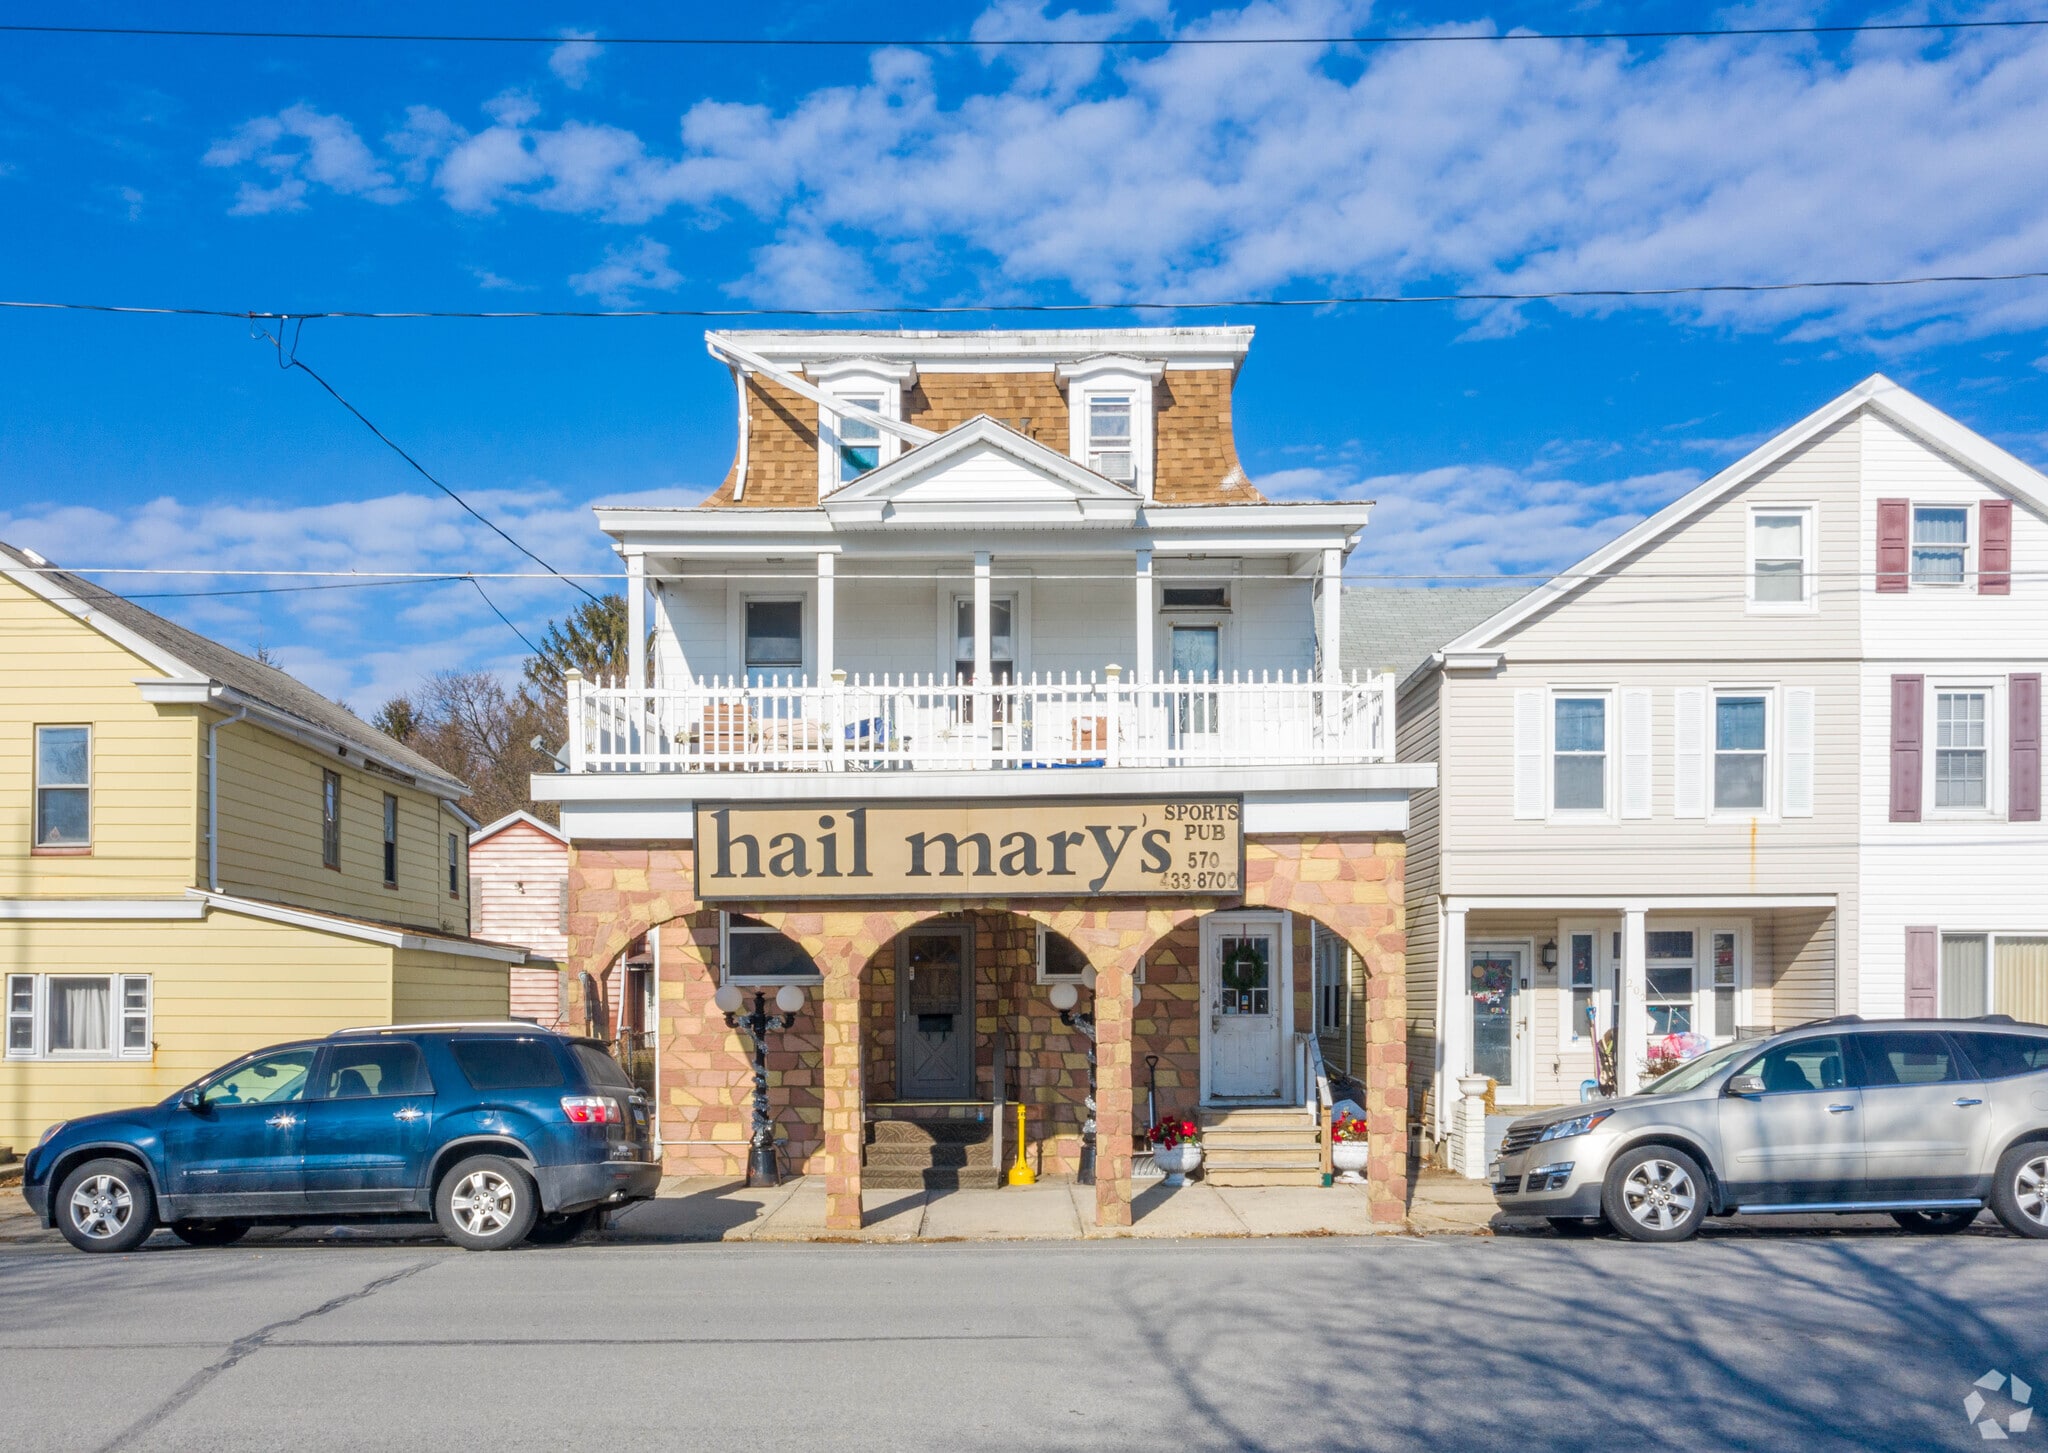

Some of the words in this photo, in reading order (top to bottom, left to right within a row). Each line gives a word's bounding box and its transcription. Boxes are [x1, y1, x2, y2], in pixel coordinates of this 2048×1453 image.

[1164, 804, 1239, 821] SPORTS
[1184, 824, 1226, 841] PUB
[710, 807, 873, 878] hail
[904, 813, 1173, 893] mary's
[1187, 850, 1220, 869] 570
